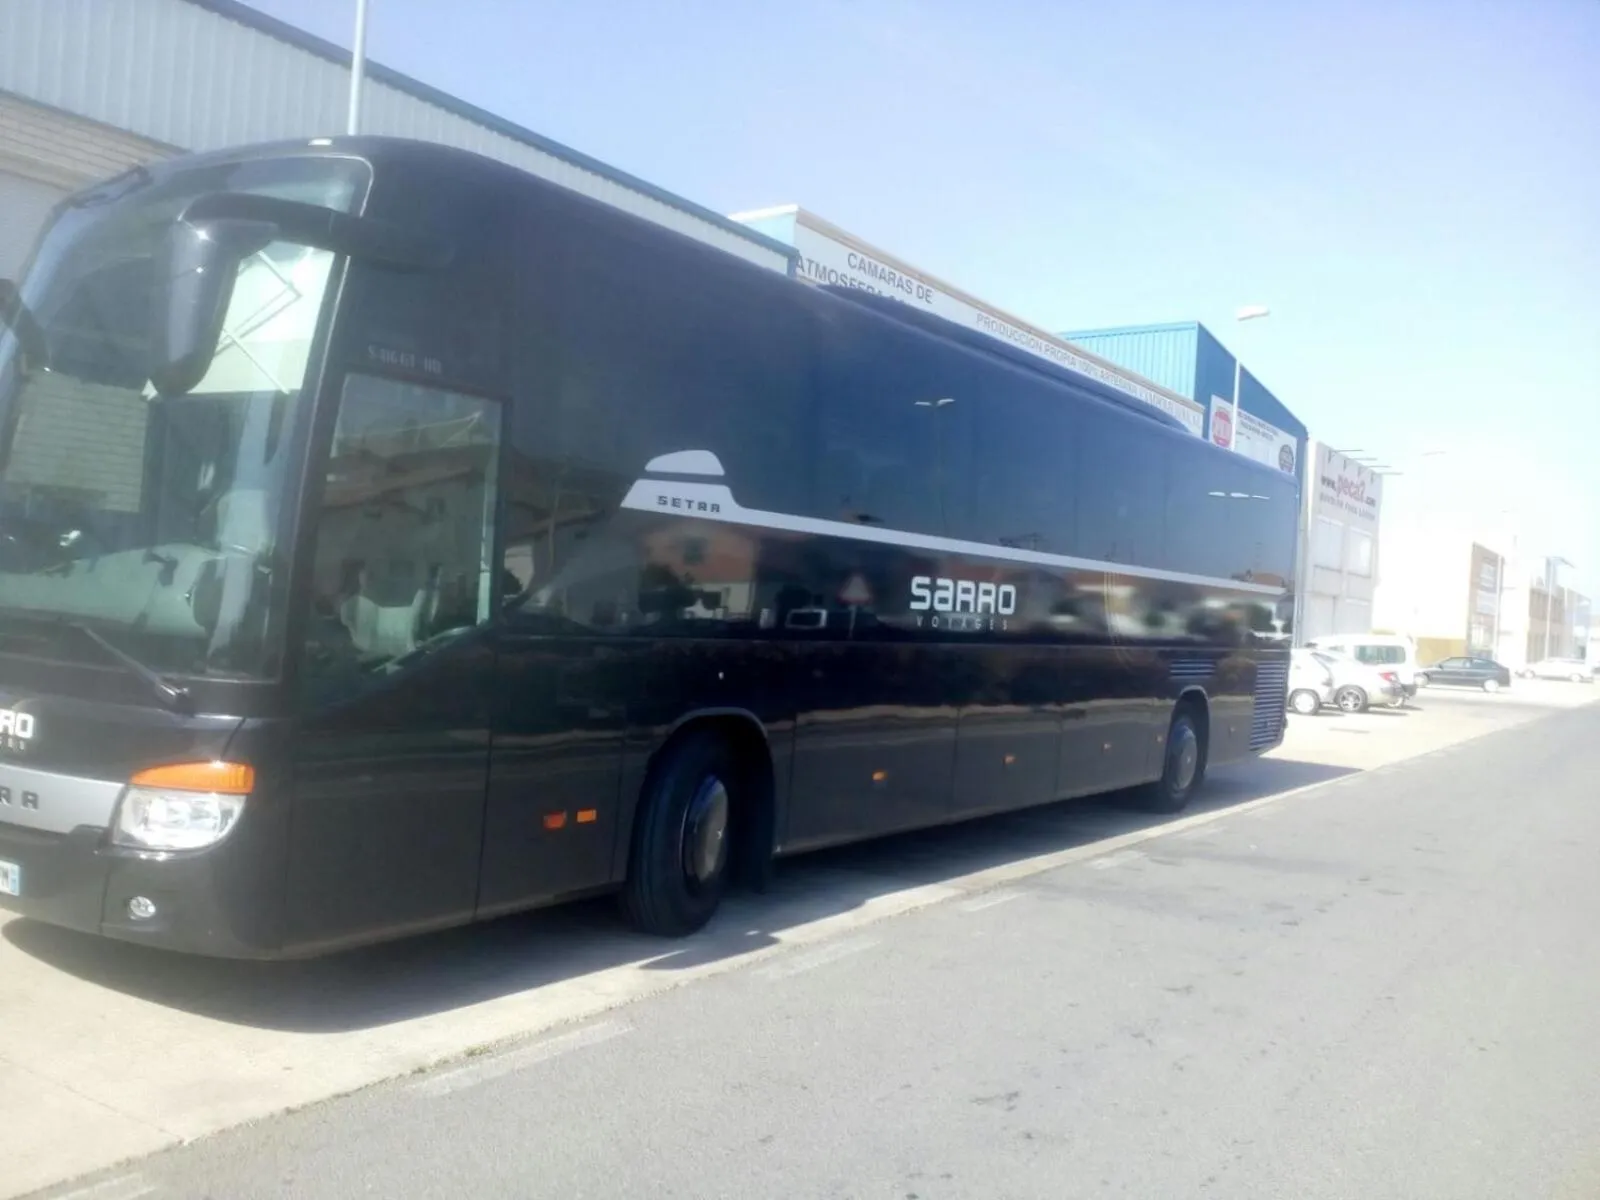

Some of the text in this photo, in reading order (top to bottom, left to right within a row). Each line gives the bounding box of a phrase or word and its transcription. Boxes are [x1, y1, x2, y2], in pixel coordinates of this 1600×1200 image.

[847, 252, 933, 304] CAMARAS DE
[657, 495, 721, 513] SETRA
